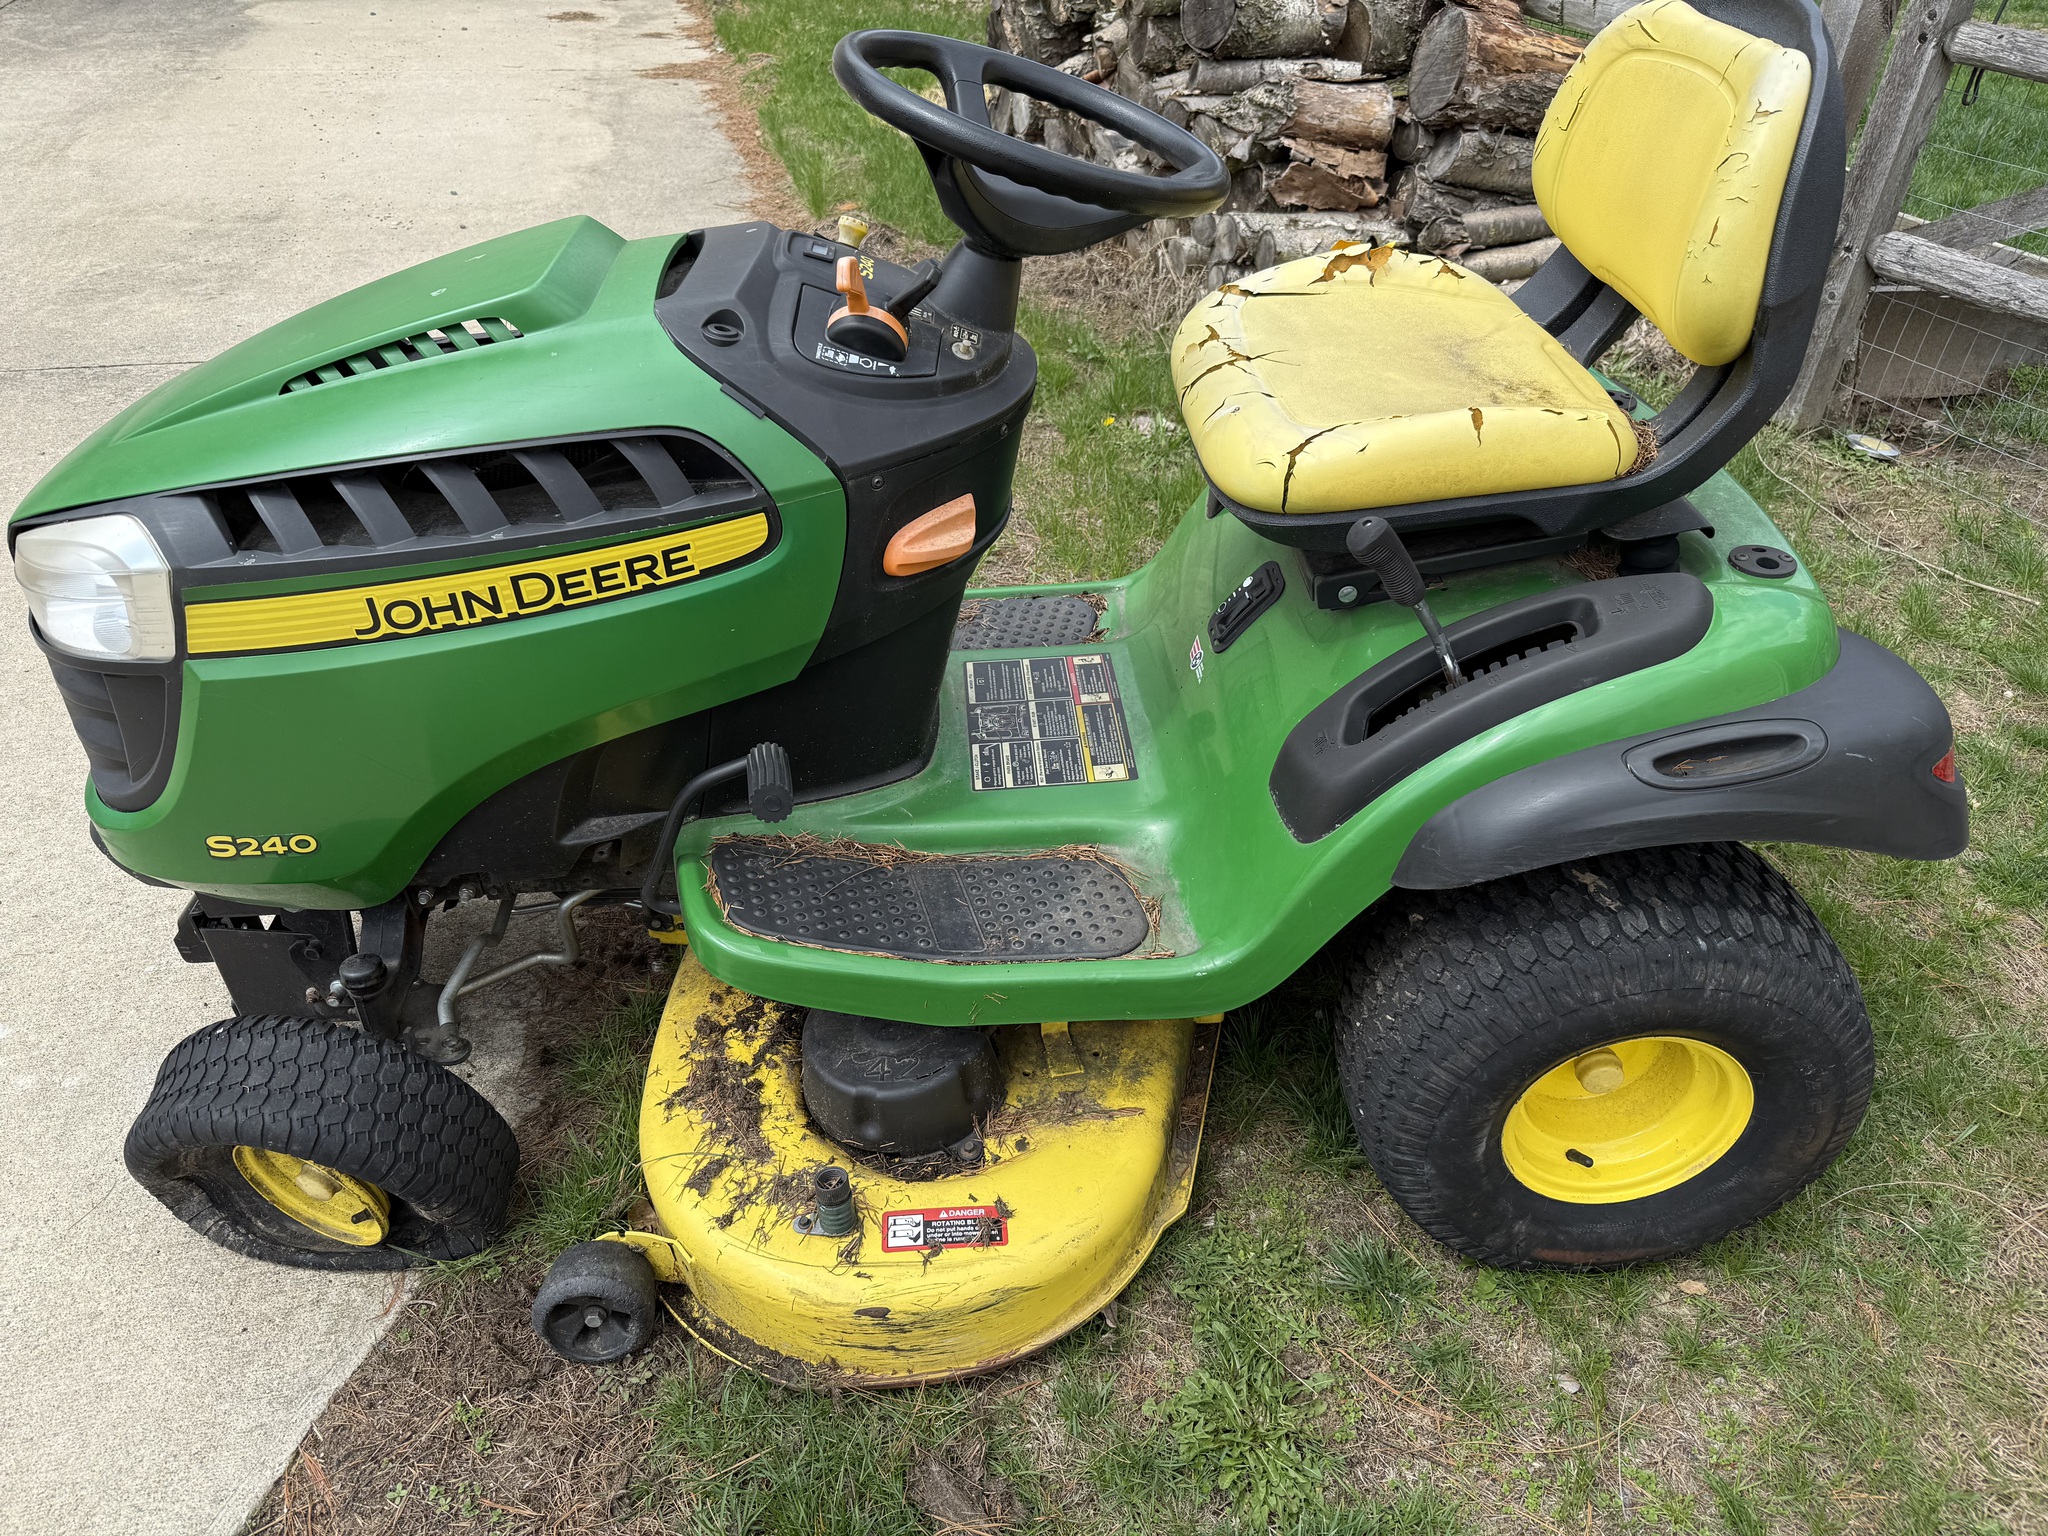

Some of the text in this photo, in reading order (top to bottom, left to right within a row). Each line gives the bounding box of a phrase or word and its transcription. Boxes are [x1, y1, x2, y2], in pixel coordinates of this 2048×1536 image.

[354, 544, 696, 637] JOHN DEERE
[206, 833, 318, 859] S240
[864, 1056, 920, 1082] 42
[932, 1219, 966, 1227] ROTATING
[949, 1208, 985, 1217] DANGER
